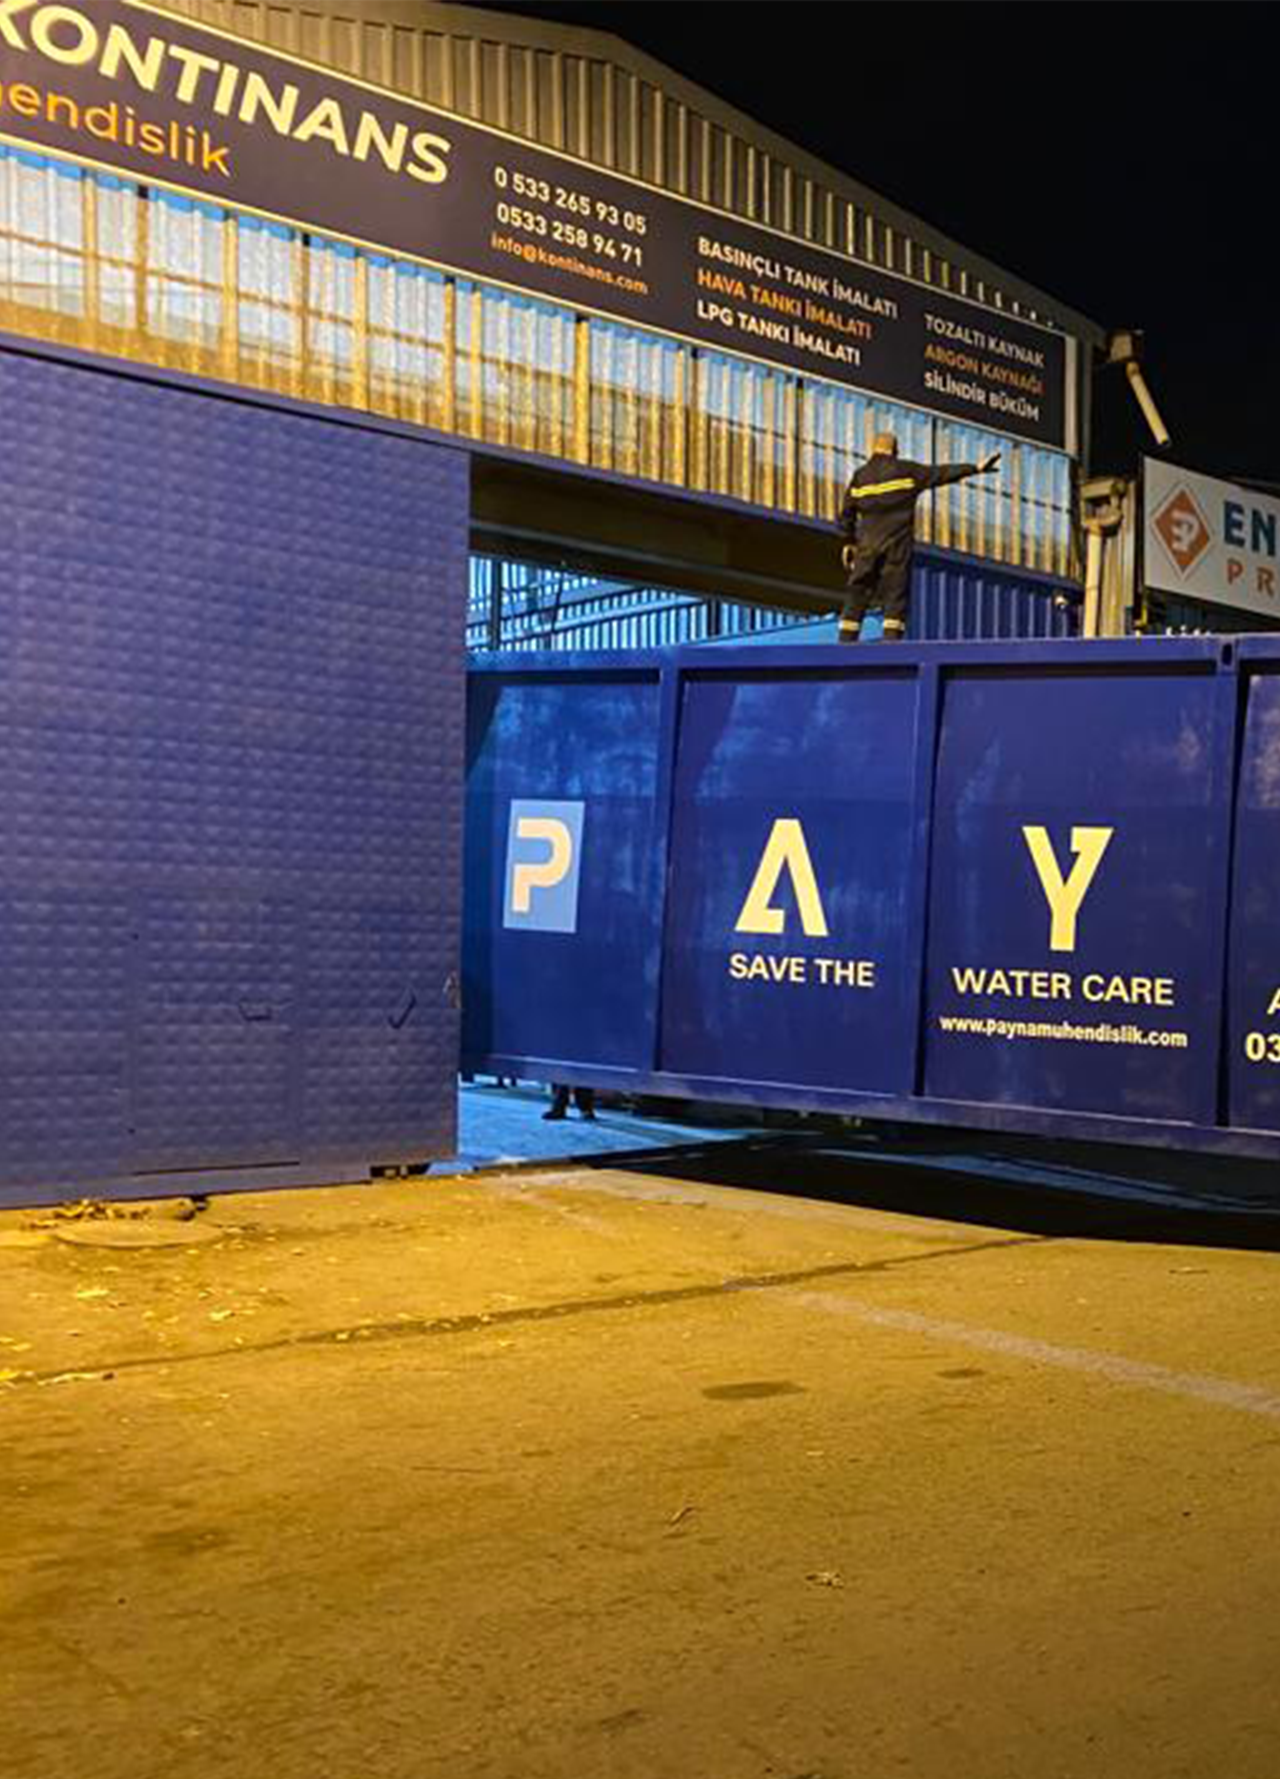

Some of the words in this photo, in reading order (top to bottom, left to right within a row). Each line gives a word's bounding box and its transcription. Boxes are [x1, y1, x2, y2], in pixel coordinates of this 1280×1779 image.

[0, 82, 231, 178] endislik
[494, 166, 508, 188] 0
[512, 172, 550, 203] 533
[555, 188, 591, 216] 265
[596, 202, 619, 226] 93
[623, 211, 647, 236] 05
[497, 202, 548, 236] 0533
[552, 221, 589, 249] 258
[593, 234, 617, 259] 94
[620, 242, 643, 268] 71
[698, 235, 781, 279] BASINÇLI
[785, 265, 830, 297] TANK
[833, 278, 898, 320] İMALATI
[698, 268, 748, 300] HAVA
[751, 285, 802, 317] TANKI
[805, 299, 872, 340] İMALATI
[697, 300, 735, 328] LPG
[738, 311, 790, 345] TANKI
[794, 325, 861, 366] İMALATI
[924, 313, 986, 350] TOZALTI
[988, 334, 1044, 368] KAYNAK
[924, 342, 979, 376] ARGON
[988, 391, 1040, 422] BÜKÜM
[729, 953, 806, 983] SAVE
[815, 958, 875, 987] THE
[952, 967, 1072, 1000] WATER
[1082, 974, 1174, 1006] CARE
[939, 1016, 1188, 1047] www.paynamuhendislik.com
